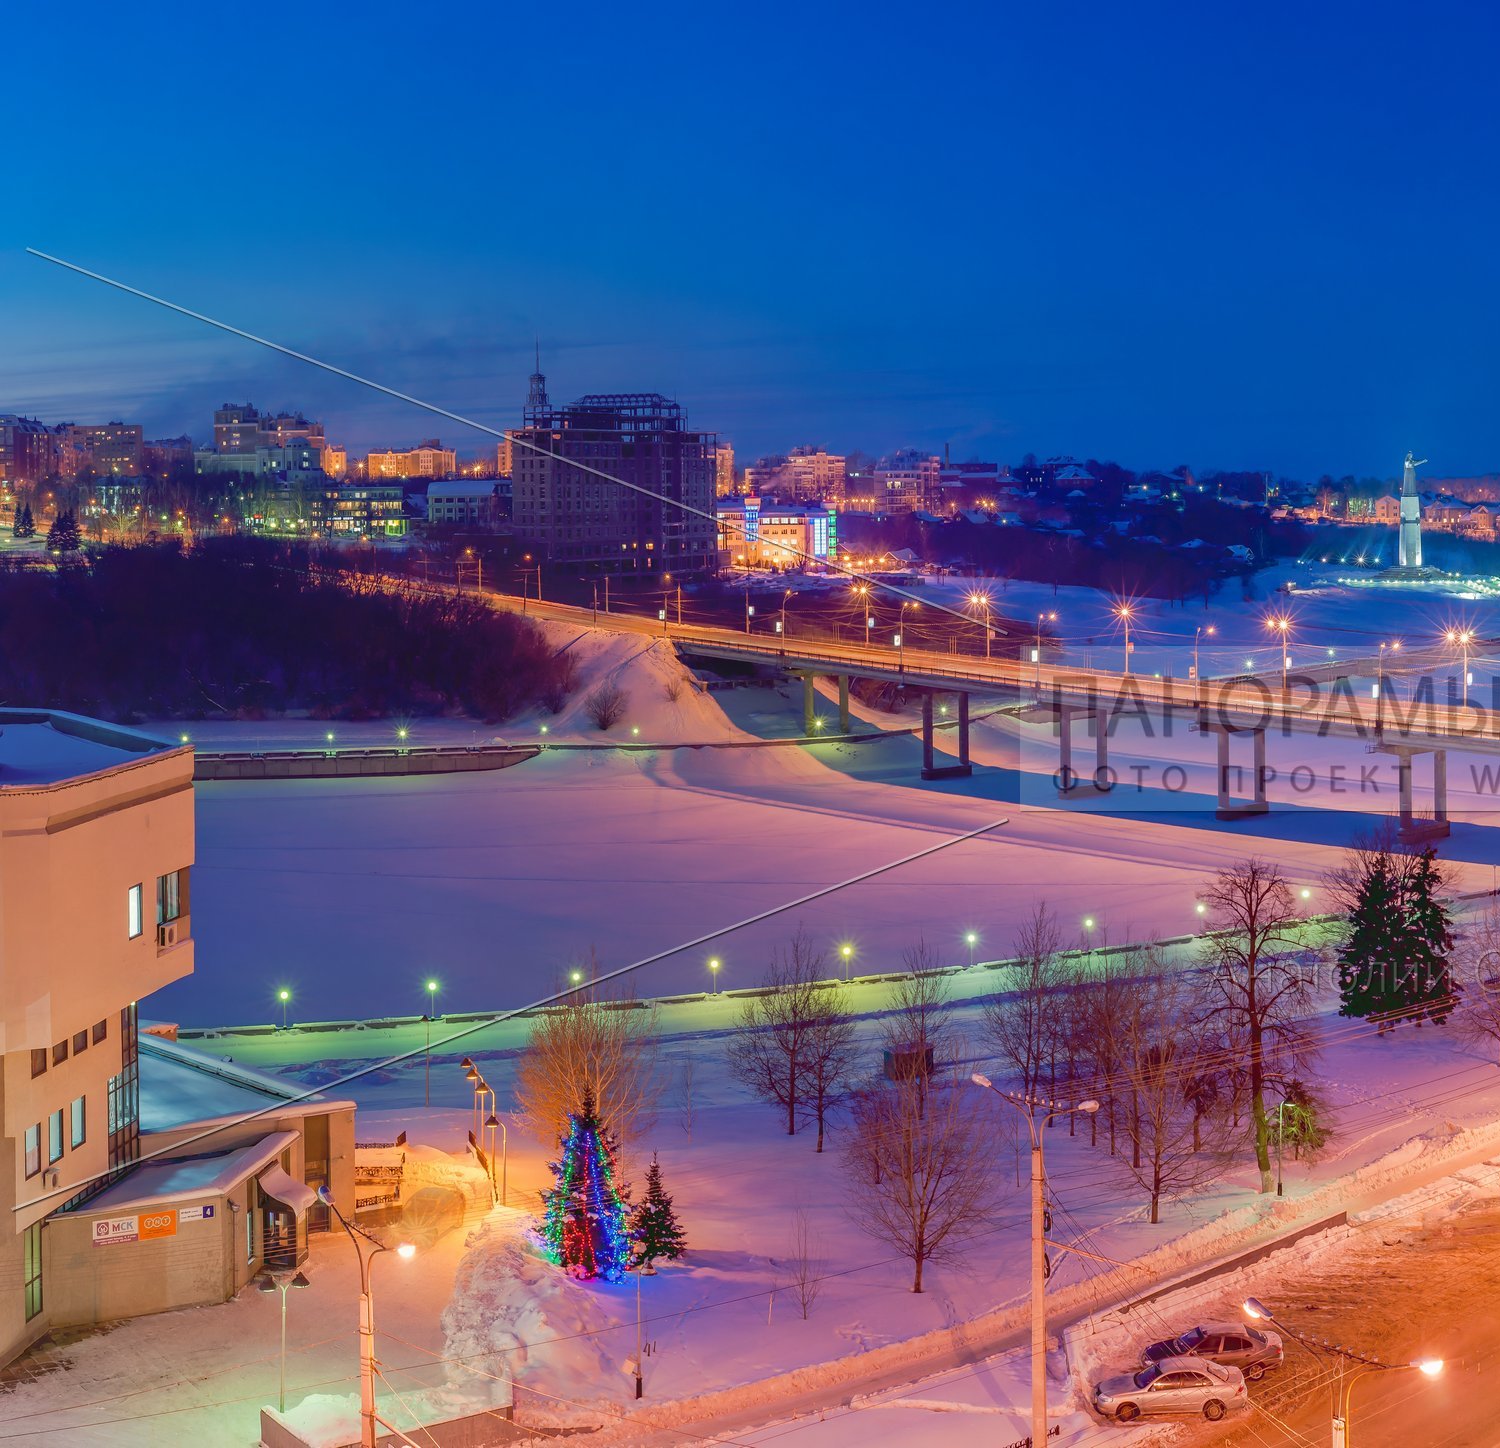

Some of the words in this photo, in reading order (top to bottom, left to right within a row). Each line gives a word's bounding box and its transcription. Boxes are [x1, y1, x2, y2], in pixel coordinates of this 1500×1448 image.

[205, 1207, 211, 1216] 4
[112, 1221, 134, 1232] МСК
[145, 1216, 170, 1228] TNT
